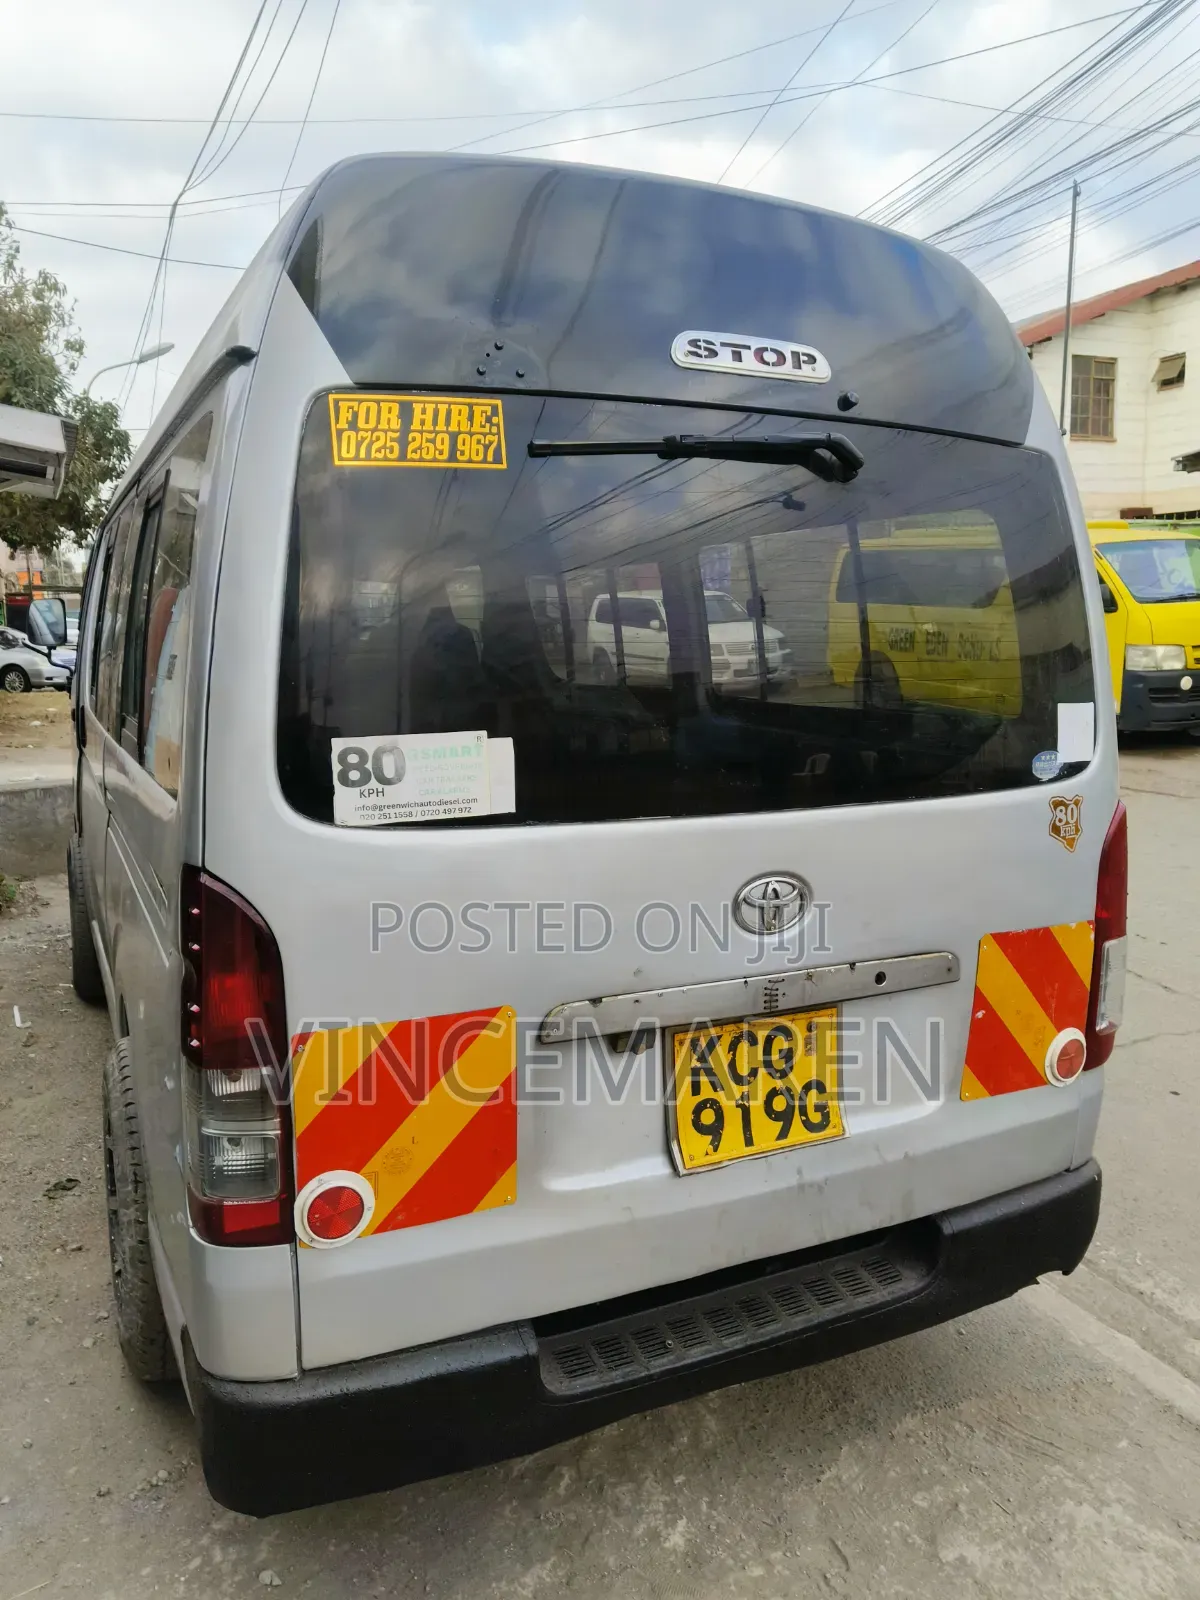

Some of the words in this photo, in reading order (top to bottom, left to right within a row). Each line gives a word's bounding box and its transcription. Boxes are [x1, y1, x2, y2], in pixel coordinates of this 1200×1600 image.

[686, 338, 817, 371] STOP
[336, 401, 401, 429] FOR
[410, 402, 499, 433] HIRE:
[340, 430, 400, 459] 0725
[406, 432, 450, 460] 259
[456, 433, 499, 462] 967
[336, 744, 406, 788] 80
[354, 797, 478, 812] info@greenwichautodiesel.com
[359, 787, 385, 799] KPH
[377, 812, 392, 820] 251
[420, 808, 440, 817] 0720
[441, 807, 456, 815] 497
[457, 806, 472, 814] 972
[1055, 803, 1077, 826] 80
[690, 1024, 795, 1097] KCG
[691, 1078, 831, 1156] 919G
